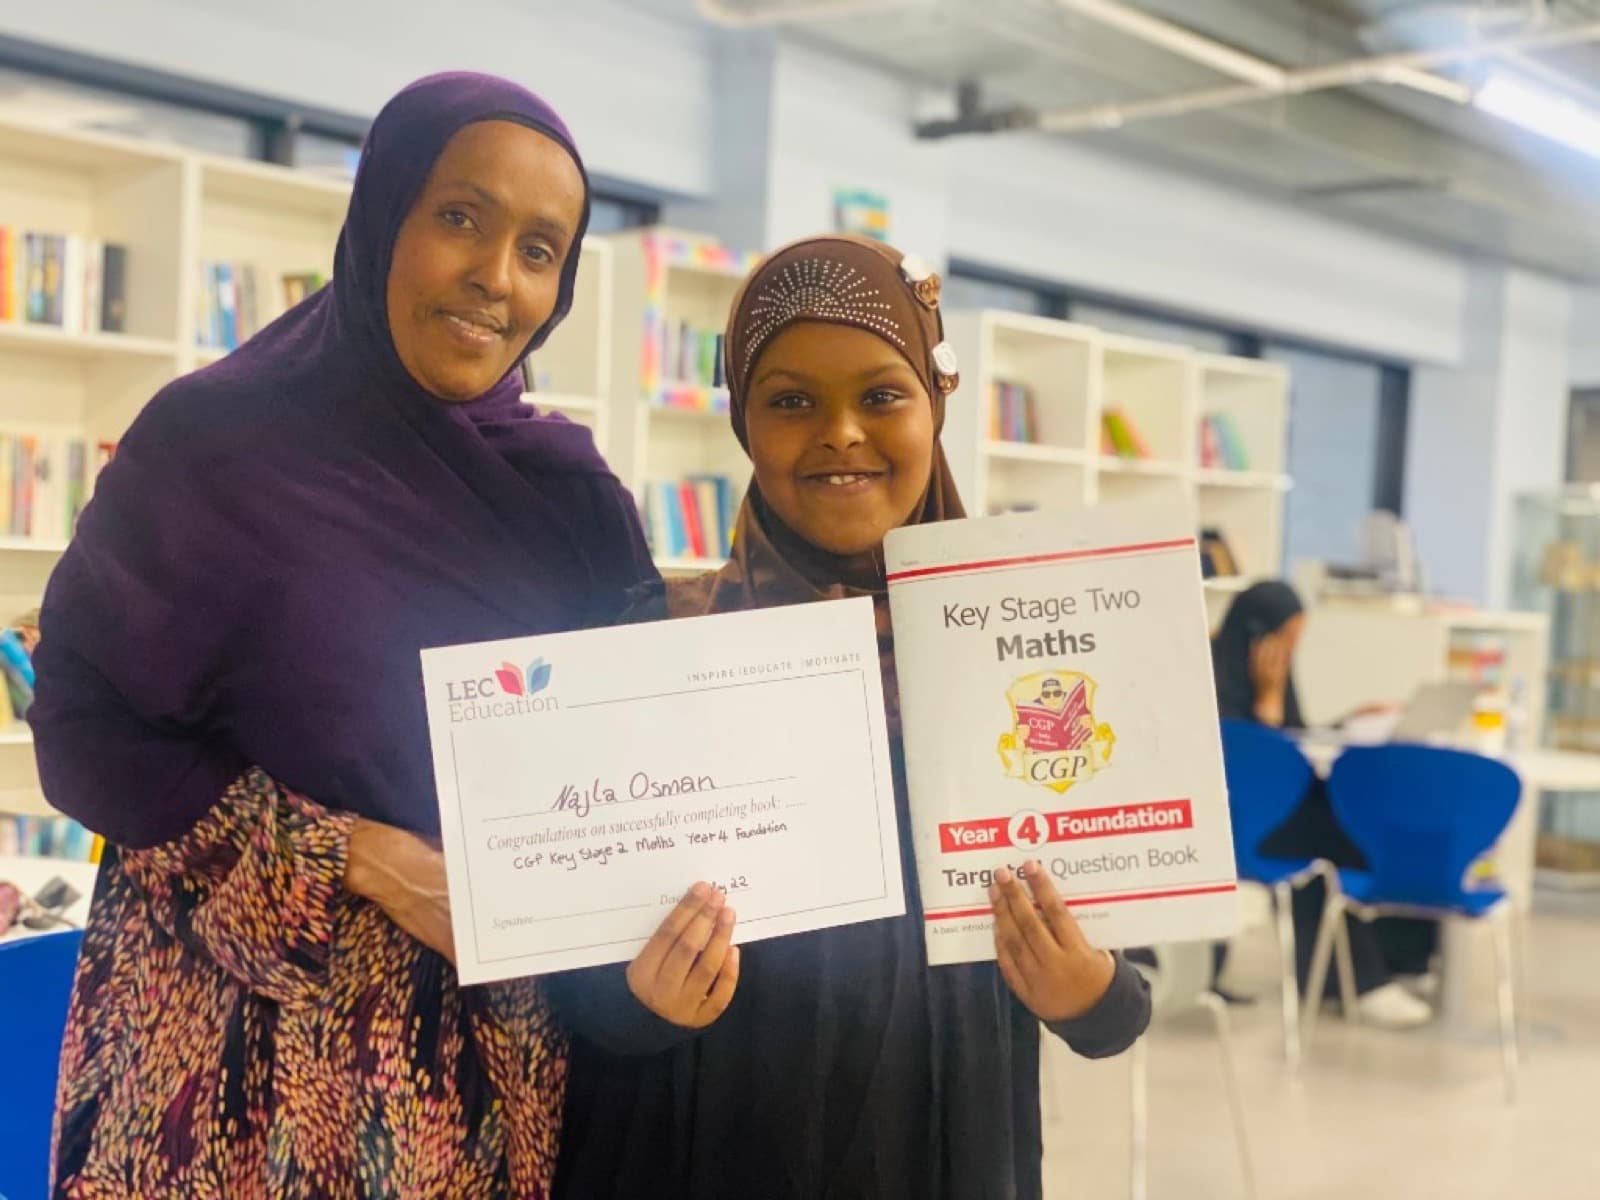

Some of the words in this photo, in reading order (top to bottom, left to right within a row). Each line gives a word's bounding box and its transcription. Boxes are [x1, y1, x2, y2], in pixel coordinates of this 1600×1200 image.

[942, 603, 990, 630] Key
[1000, 595, 1077, 622] Stage
[1085, 588, 1140, 612] Two
[996, 628, 1096, 661] Maths
[446, 677, 495, 702] LEC
[687, 668, 735, 683] INSPIRE
[448, 695, 560, 723] Education
[1029, 754, 1088, 782] CGP
[551, 778, 618, 818] Najla
[629, 771, 717, 800] Osman
[487, 824, 587, 851] Congratulations
[590, 824, 607, 837] on
[608, 809, 681, 835] successfully
[683, 801, 747, 824] completing
[948, 825, 999, 846] Year
[1015, 815, 1041, 844] 4
[1056, 805, 1184, 835] Foundation
[513, 853, 543, 869] CGP
[550, 852, 577, 871] Key
[578, 845, 613, 865] Stage
[617, 841, 629, 854] 2
[718, 829, 729, 842] 4
[1050, 852, 1140, 881] Question
[1147, 844, 1200, 869] Book
[730, 875, 750, 890] 22
